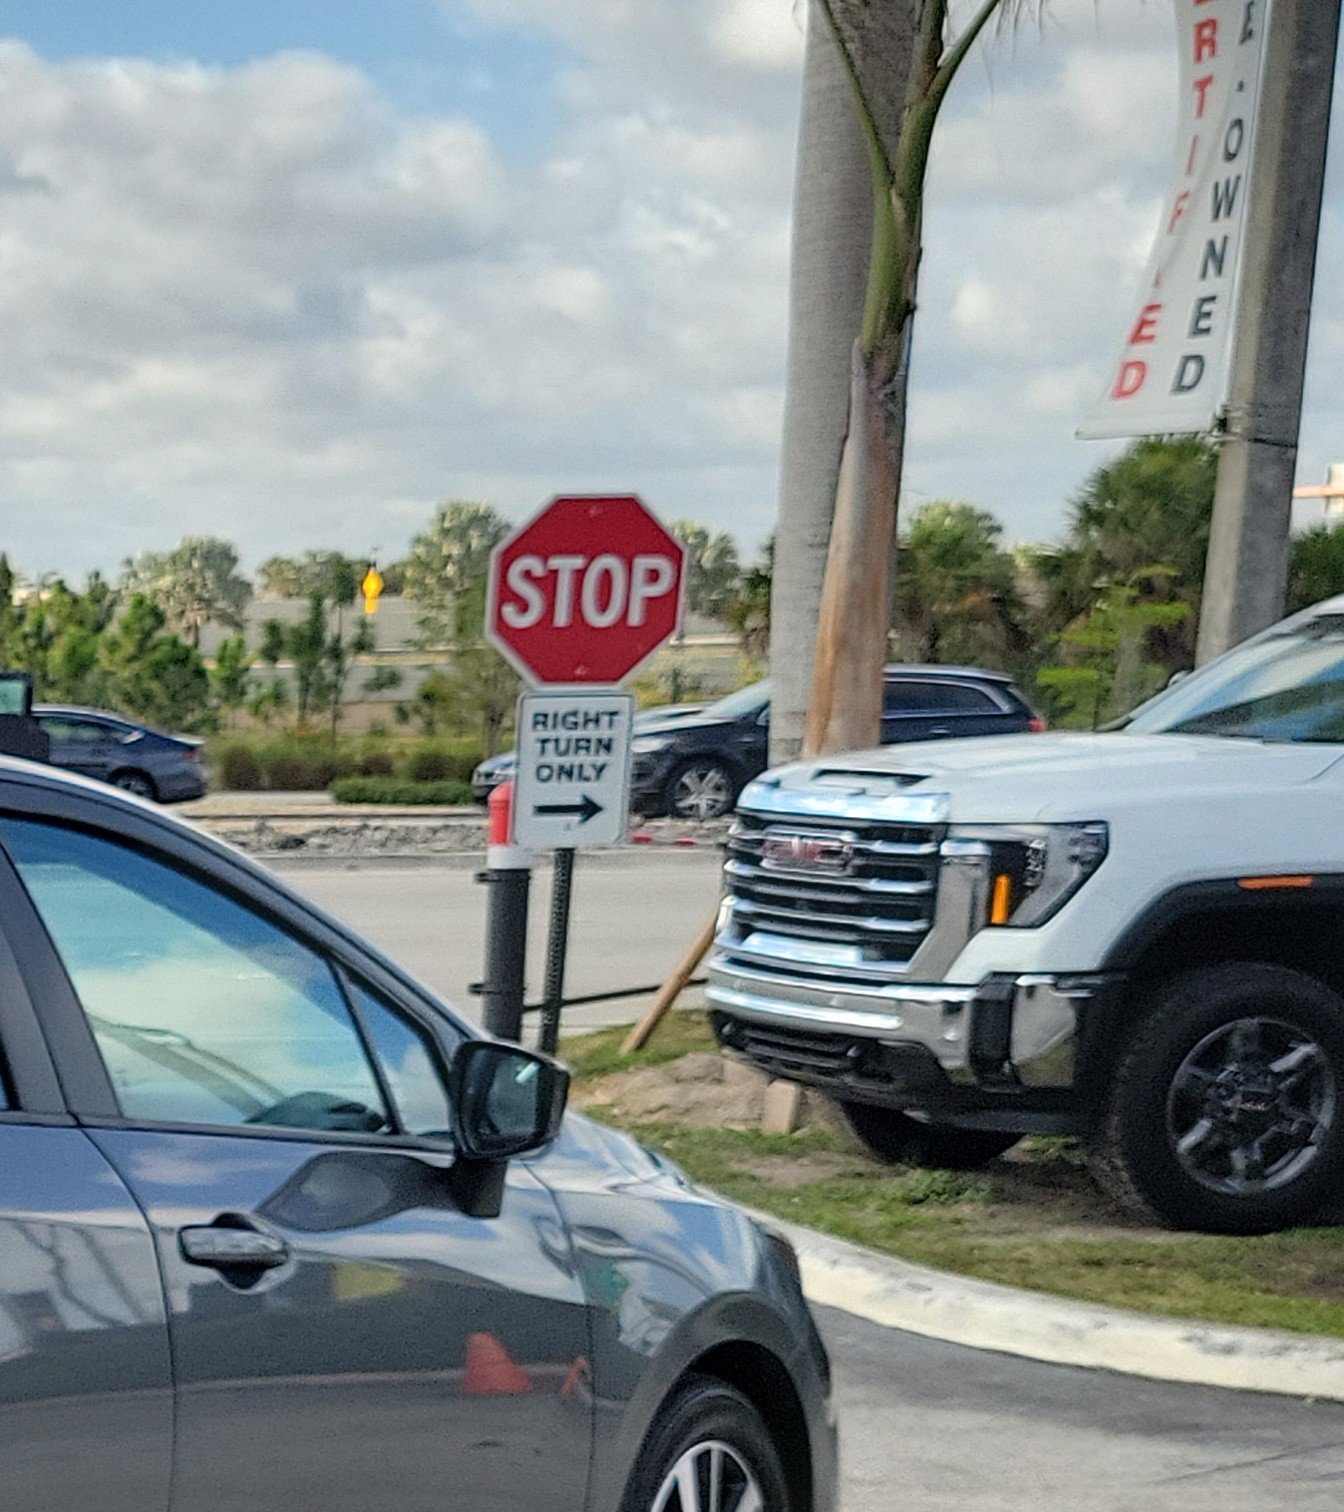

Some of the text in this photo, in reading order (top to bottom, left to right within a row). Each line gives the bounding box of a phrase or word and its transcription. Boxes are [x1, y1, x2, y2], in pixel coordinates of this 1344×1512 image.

[1112, 0, 1217, 399] RTIFIED
[500, 554, 676, 629] STOP
[531, 710, 620, 731] RIGHT
[536, 737, 614, 758] TURN
[535, 763, 609, 783] ONLY
